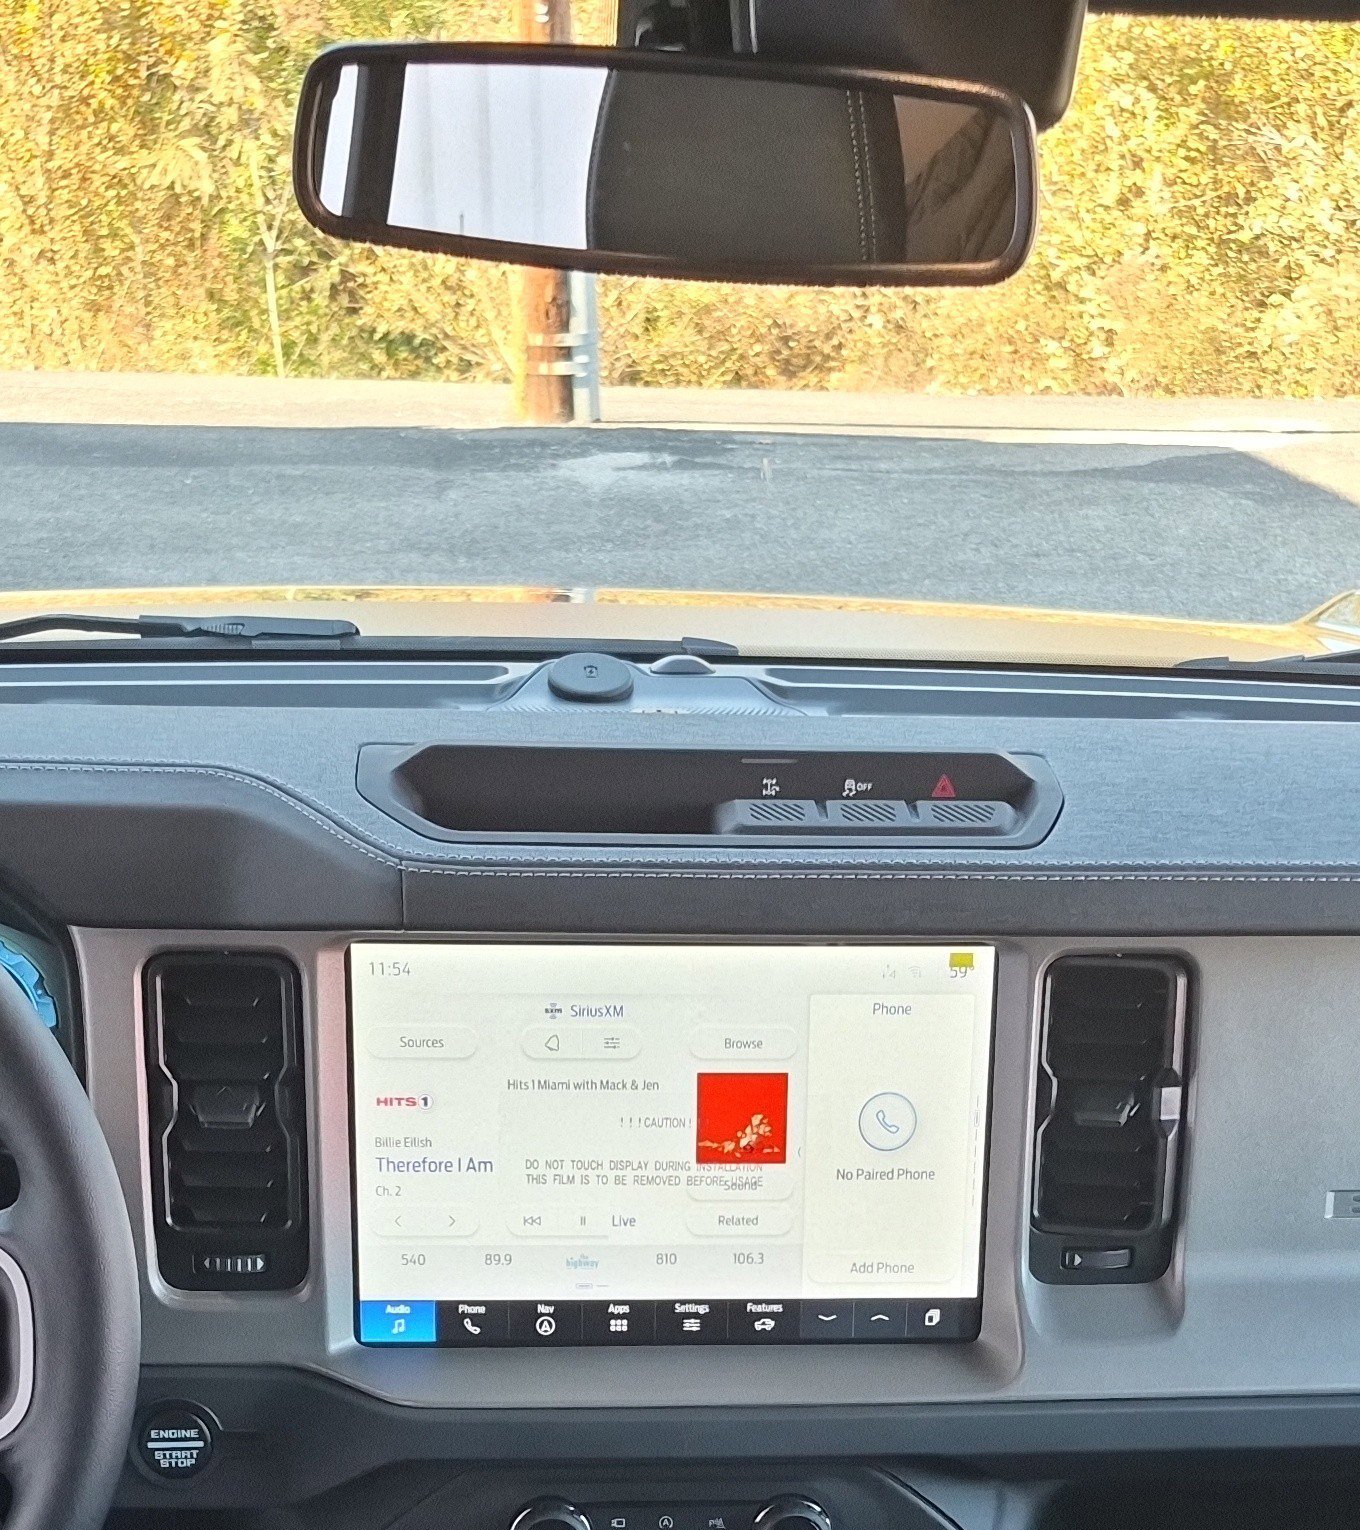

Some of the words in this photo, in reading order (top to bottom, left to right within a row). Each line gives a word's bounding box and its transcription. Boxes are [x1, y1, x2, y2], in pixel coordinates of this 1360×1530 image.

[368, 962, 411, 976] 11:54
[570, 1004, 624, 1018] SiriusXM
[873, 1002, 912, 1016] Phone
[400, 1036, 444, 1049] Sources
[724, 1037, 763, 1050] Browse
[507, 1079, 529, 1091] Hits
[537, 1079, 570, 1091] Miami
[572, 1079, 597, 1091] with
[600, 1079, 629, 1091] Mack
[631, 1079, 639, 1091] &
[641, 1079, 659, 1091] Jen
[644, 1117, 686, 1128] CAUTION
[375, 1137, 401, 1148] Billie
[403, 1137, 433, 1148] Eilish
[375, 1157, 454, 1174] Therefore
[466, 1158, 494, 1173] Am
[525, 1159, 539, 1170] DO
[545, 1159, 565, 1170] NOT
[570, 1159, 604, 1170] TOUCH
[609, 1159, 649, 1171] DISPLAY
[654, 1160, 691, 1172] DURING
[525, 1174, 547, 1186] THIS
[553, 1174, 576, 1186] FILM
[580, 1174, 590, 1186] IS
[596, 1174, 609, 1186] TO
[614, 1174, 628, 1186] BE
[633, 1175, 681, 1186] REMOVED
[686, 1175, 725, 1186] BEFORE
[836, 1168, 854, 1181] No
[856, 1168, 895, 1181] Paired
[897, 1168, 935, 1181] Phone
[375, 1186, 392, 1197] Ch.
[394, 1186, 402, 1197] 2
[612, 1215, 636, 1227] Live
[718, 1215, 759, 1227] Related
[400, 1254, 426, 1266] 540
[484, 1254, 513, 1266] 89.9
[655, 1253, 678, 1265] 810
[733, 1253, 764, 1265] 106.3
[850, 1262, 875, 1274] Add
[876, 1262, 915, 1274] Phone
[385, 1304, 411, 1315] Audio
[458, 1304, 486, 1315] Phone
[537, 1304, 555, 1315] Nav
[608, 1304, 630, 1316] Apps
[674, 1303, 710, 1314] Settings
[746, 1302, 783, 1313] Features
[150, 1429, 199, 1439] ENGINE
[154, 1449, 199, 1460] START
[160, 1459, 196, 1468] STOP
